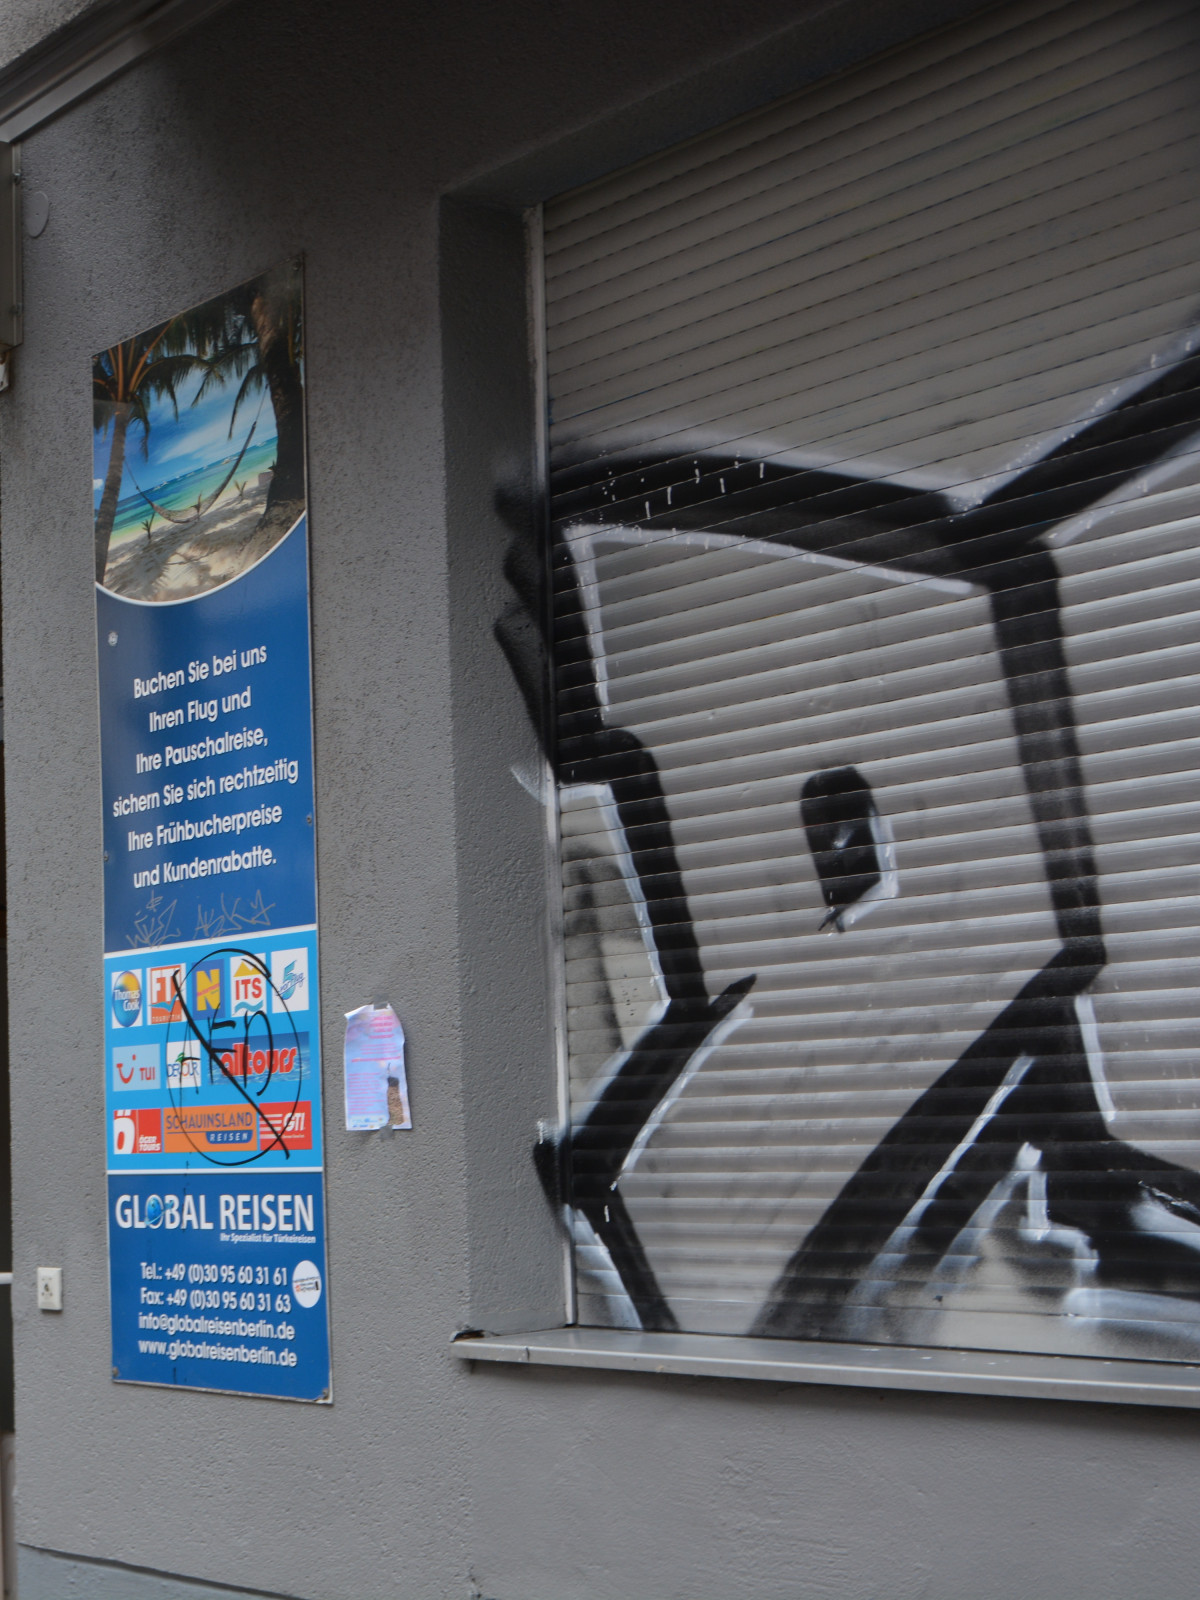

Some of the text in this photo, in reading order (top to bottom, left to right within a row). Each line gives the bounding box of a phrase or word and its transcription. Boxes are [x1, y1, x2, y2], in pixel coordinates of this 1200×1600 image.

[133, 645, 267, 699] Buchen Sie bei uns
[149, 686, 251, 733] Ihren Flug und
[136, 727, 268, 774] Ihre Pauschalreise,
[113, 759, 299, 818] sichern Sie sich rechtzeitig
[128, 804, 282, 852] Ihre Frühbucherpreise
[133, 845, 277, 889] und Kundenrabatte.
[235, 978, 262, 1000] ITS
[140, 1067, 156, 1081] TUI
[166, 1112, 253, 1130] SCHAUINSLAND
[283, 1112, 305, 1131] GTI
[139, 1143, 161, 1152] TOURS
[209, 1132, 248, 1141] REISEN
[115, 1194, 314, 1232] GLOBAL REISEN
[165, 1263, 186, 1280] +49
[188, 1264, 218, 1284] (0)30
[220, 1265, 235, 1283] 95
[238, 1266, 253, 1284] 60
[255, 1266, 269, 1285] 31
[273, 1267, 287, 1286] 61
[140, 1287, 291, 1313] Fax: +49 (0)30 95 60 31 63
[138, 1312, 295, 1341] info@globalreisenberlin.de
[138, 1339, 297, 1367] www.globalreisenberlin.de
